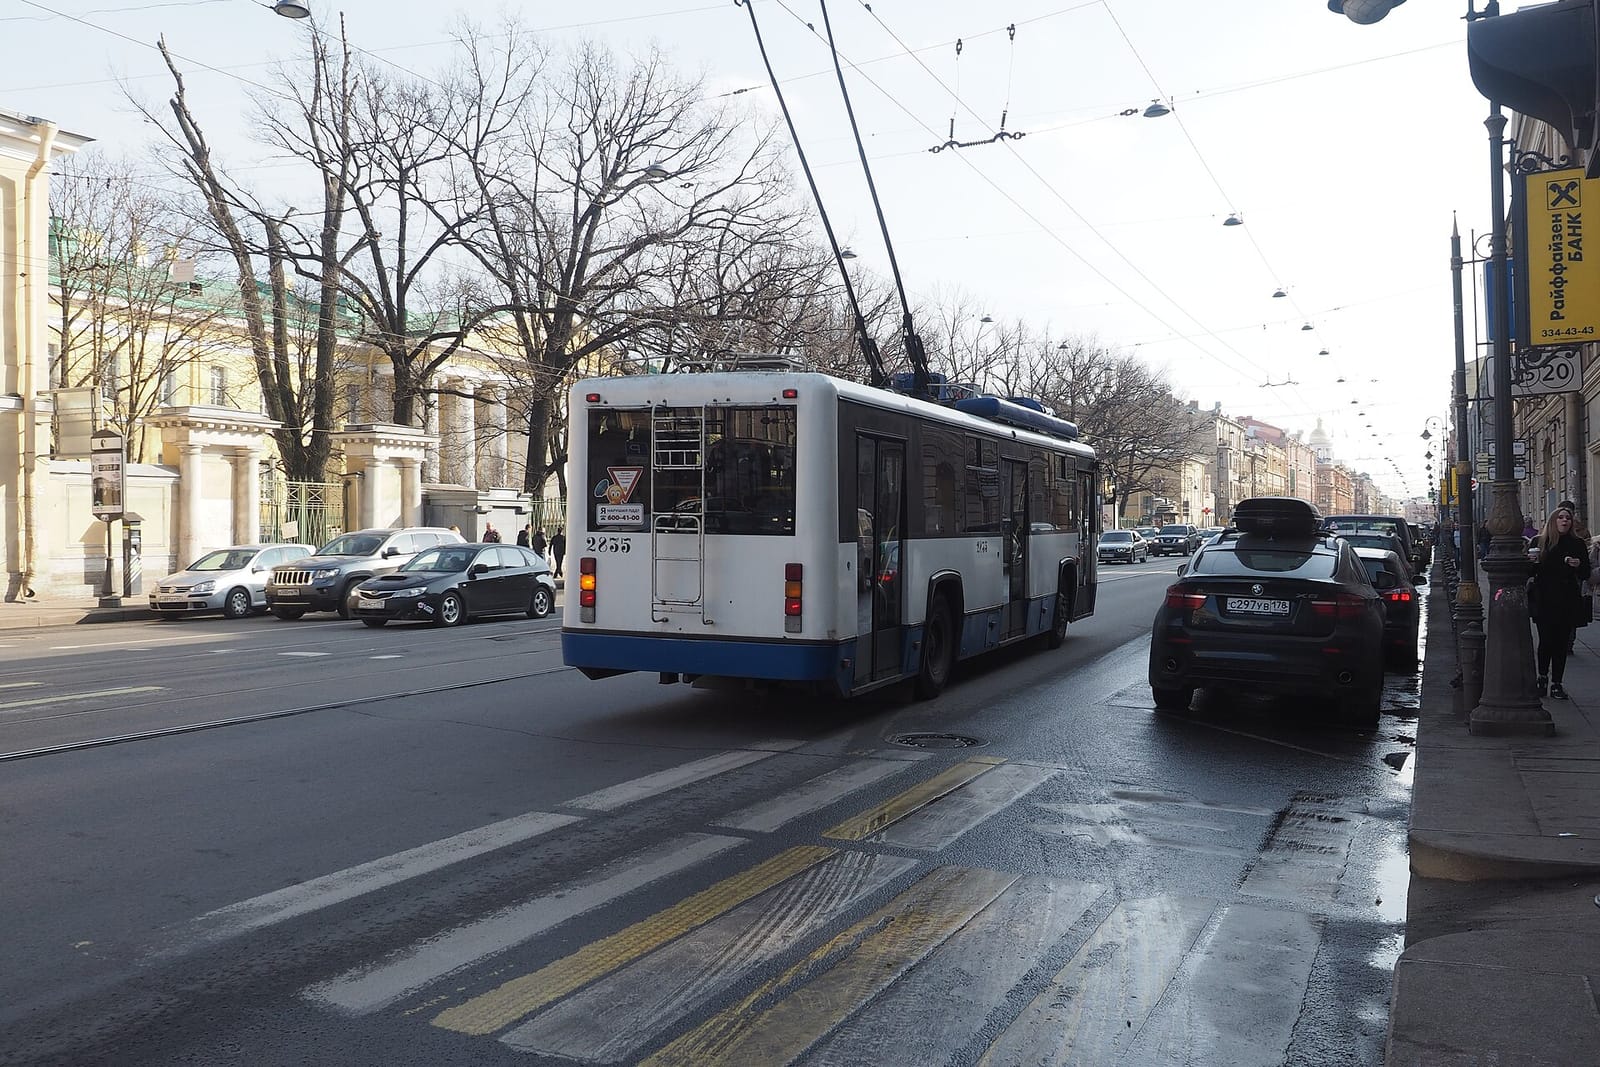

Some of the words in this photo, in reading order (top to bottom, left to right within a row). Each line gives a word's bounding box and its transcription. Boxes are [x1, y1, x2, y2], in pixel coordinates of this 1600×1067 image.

[1567, 212, 1583, 262] БАНК
[1548, 213, 1568, 320] Райффайзен
[1541, 326, 1594, 337] 334-43-43
[1543, 363, 1569, 381] 20
